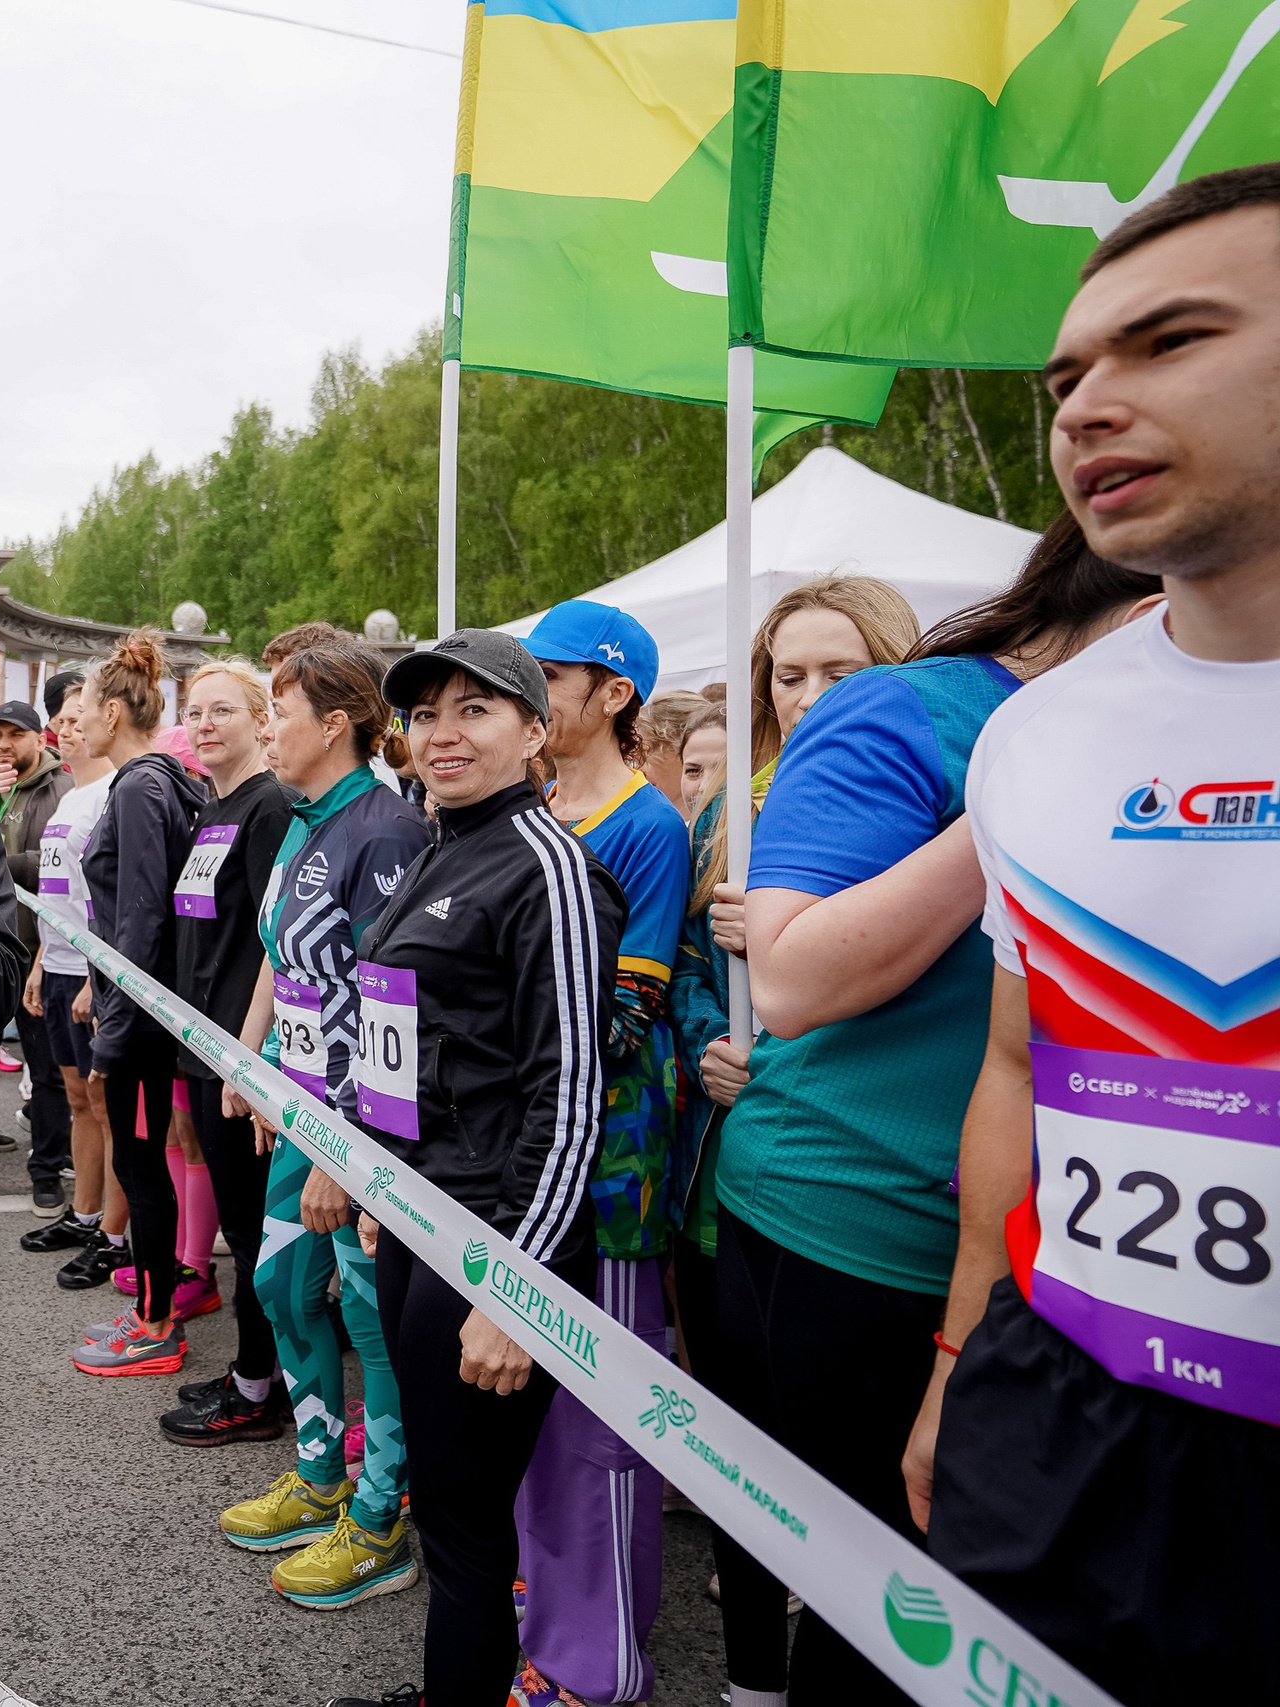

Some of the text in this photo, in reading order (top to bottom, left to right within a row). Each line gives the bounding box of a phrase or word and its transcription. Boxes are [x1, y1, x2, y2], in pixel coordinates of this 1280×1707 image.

[182, 855, 219, 881] 2144
[424, 905, 449, 920] adidas
[191, 1026, 228, 1062] СБЕРБАНК
[1086, 1078, 1138, 1097] СБЕР
[296, 1109, 353, 1167] СБЕРБАНК
[384, 1188, 436, 1237] ЗЕЛЕНЫЙ МАРАФОН
[1065, 1156, 1272, 1286] 228
[491, 1259, 601, 1370] СБЕРБАНК
[1145, 1336, 1166, 1374] 1
[683, 1429, 809, 1542] ЗЕЛЕНЫЙ МАРАФОН
